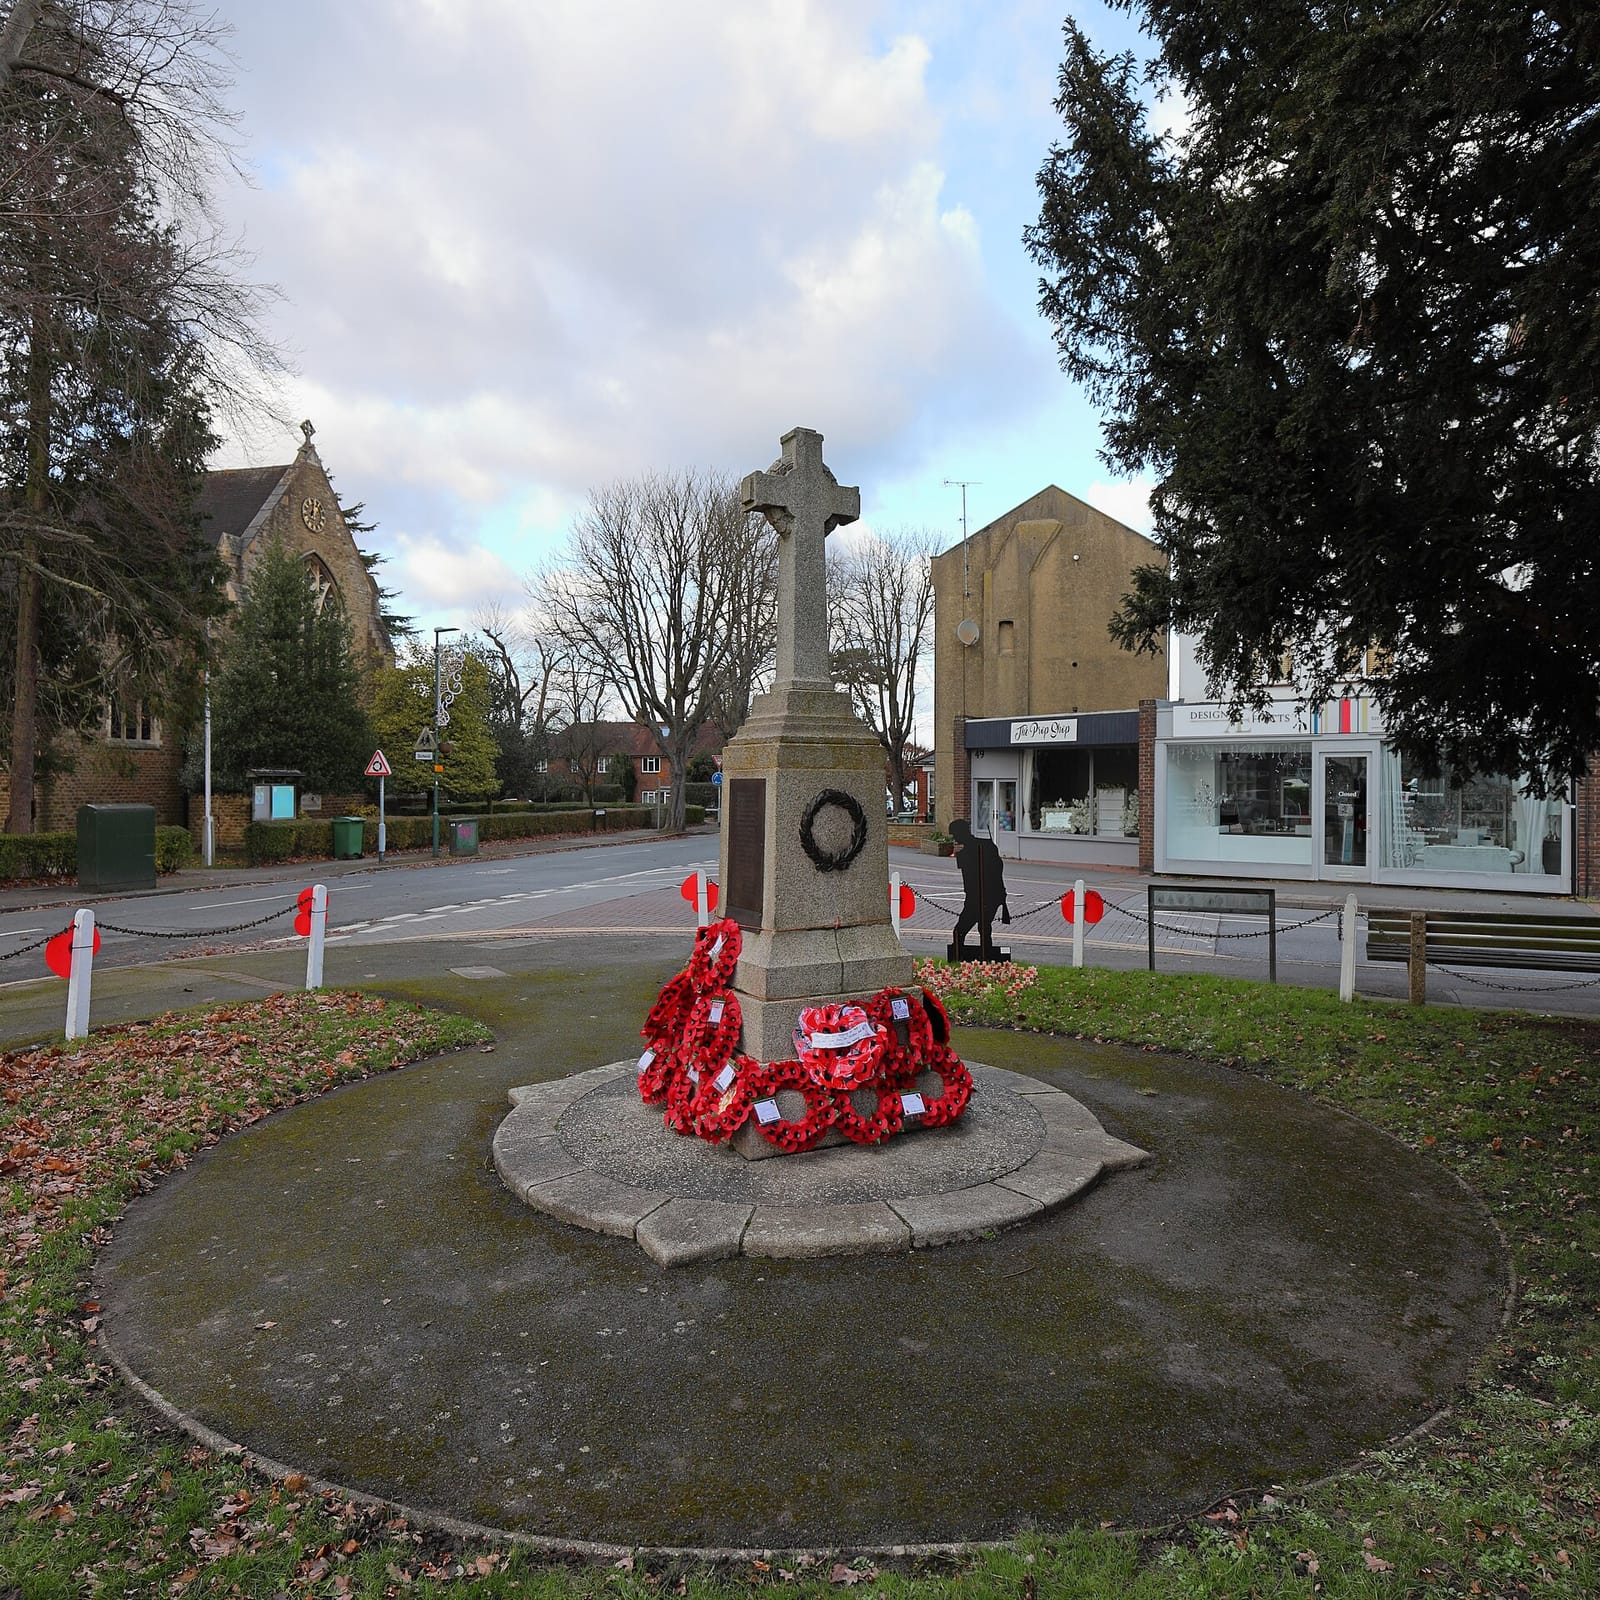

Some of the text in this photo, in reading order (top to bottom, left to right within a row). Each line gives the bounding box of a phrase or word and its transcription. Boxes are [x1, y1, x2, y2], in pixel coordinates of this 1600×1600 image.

[1190, 710, 1229, 720] DESIGN
[1014, 721, 1070, 741] The Prop Shop
[974, 749, 985, 759] 49
